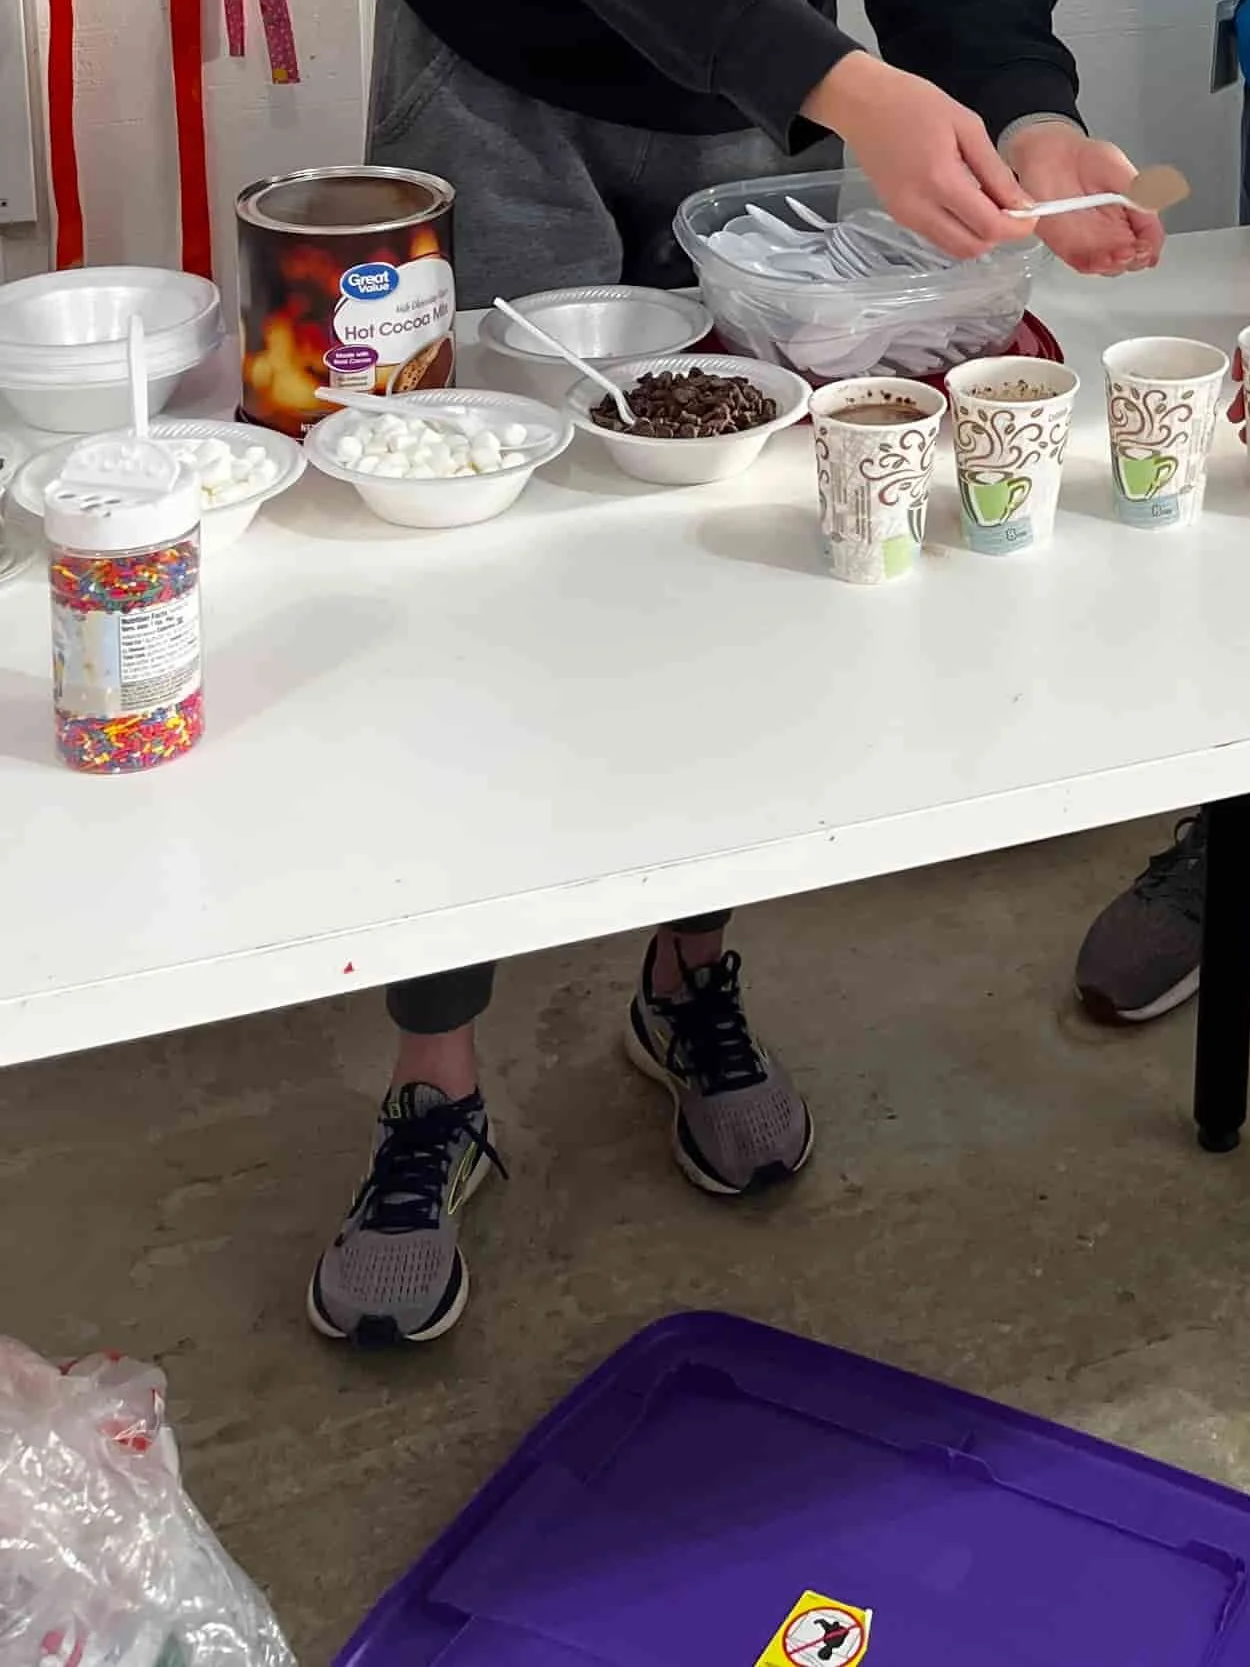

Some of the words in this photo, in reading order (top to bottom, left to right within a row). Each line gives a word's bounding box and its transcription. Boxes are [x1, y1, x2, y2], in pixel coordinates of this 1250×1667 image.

[347, 271, 389, 287] Great
[358, 283, 390, 294] Value
[344, 324, 375, 340] Hot
[379, 313, 430, 336] Cocoa
